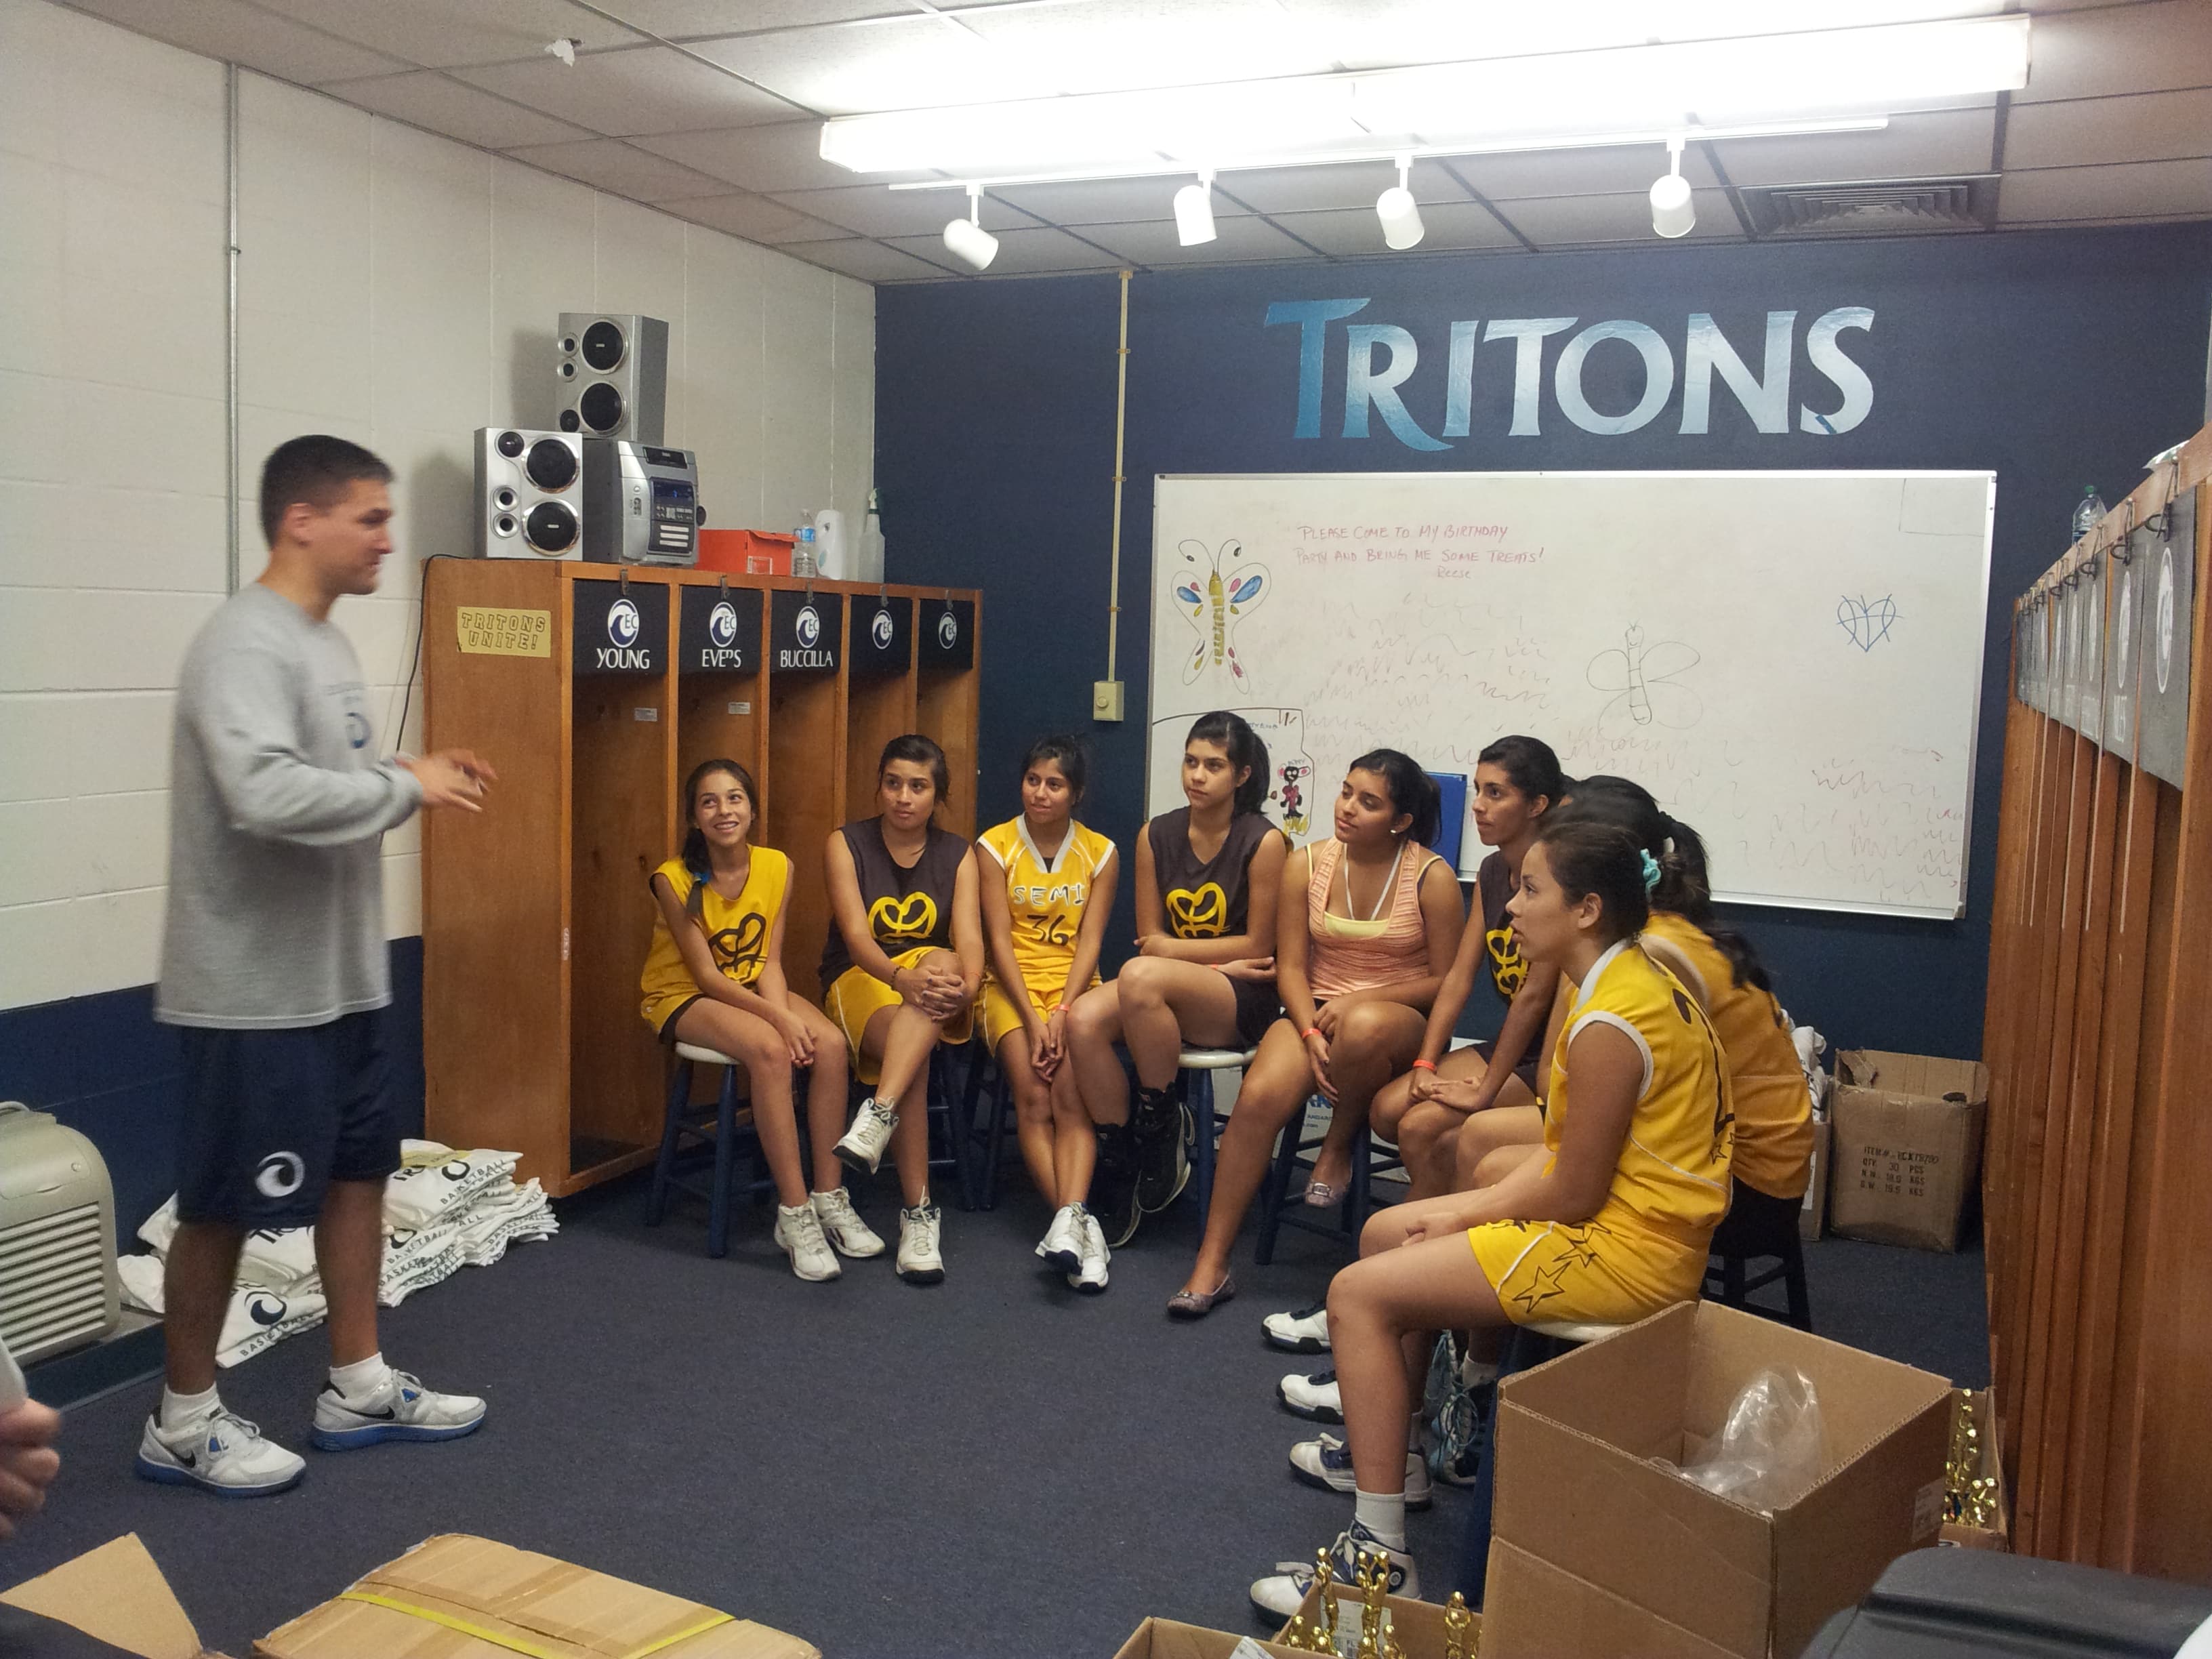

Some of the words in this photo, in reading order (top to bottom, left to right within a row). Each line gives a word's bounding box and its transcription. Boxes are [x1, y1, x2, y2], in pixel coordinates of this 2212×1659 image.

[1265, 298, 1876, 451] TRITONS
[1297, 526, 1349, 540] PLEASE
[1353, 526, 1389, 539] COME
[1395, 527, 1410, 539] TO
[1419, 525, 1438, 543] MY
[1443, 525, 1508, 543] BIRTHDAY
[1293, 548, 1328, 567] PARTY
[1334, 550, 1357, 562] AND
[1366, 548, 1408, 562] BRING
[1415, 550, 1431, 560] ME
[1441, 549, 1479, 562] SOME
[462, 612, 546, 632] TRITONS
[625, 613, 638, 630] EC
[468, 631, 537, 651] UNITE!
[596, 648, 650, 670] YOUNG
[780, 649, 833, 668] BUCCILLA
[1013, 883, 1084, 906] SEMI
[1027, 914, 1070, 947] 36
